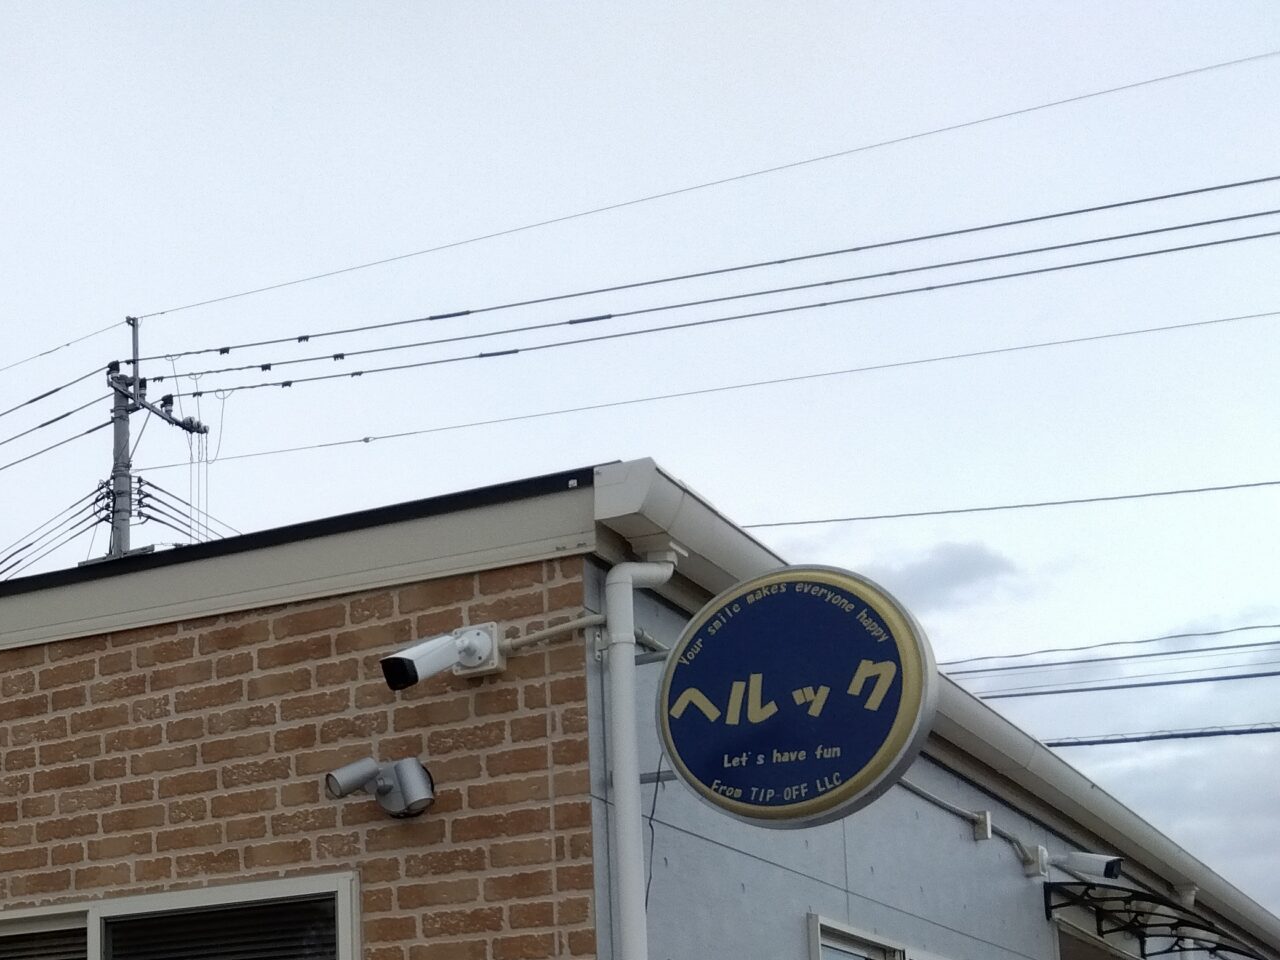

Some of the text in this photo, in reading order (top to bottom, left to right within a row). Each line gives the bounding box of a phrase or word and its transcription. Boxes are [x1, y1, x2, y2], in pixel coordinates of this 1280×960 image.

[678, 581, 889, 665] Your smile makes everyone happy
[669, 658, 897, 726] ヘルック
[772, 748, 807, 764] have
[815, 743, 841, 759] fun
[711, 779, 743, 798] From
[816, 772, 841, 792] LLC
